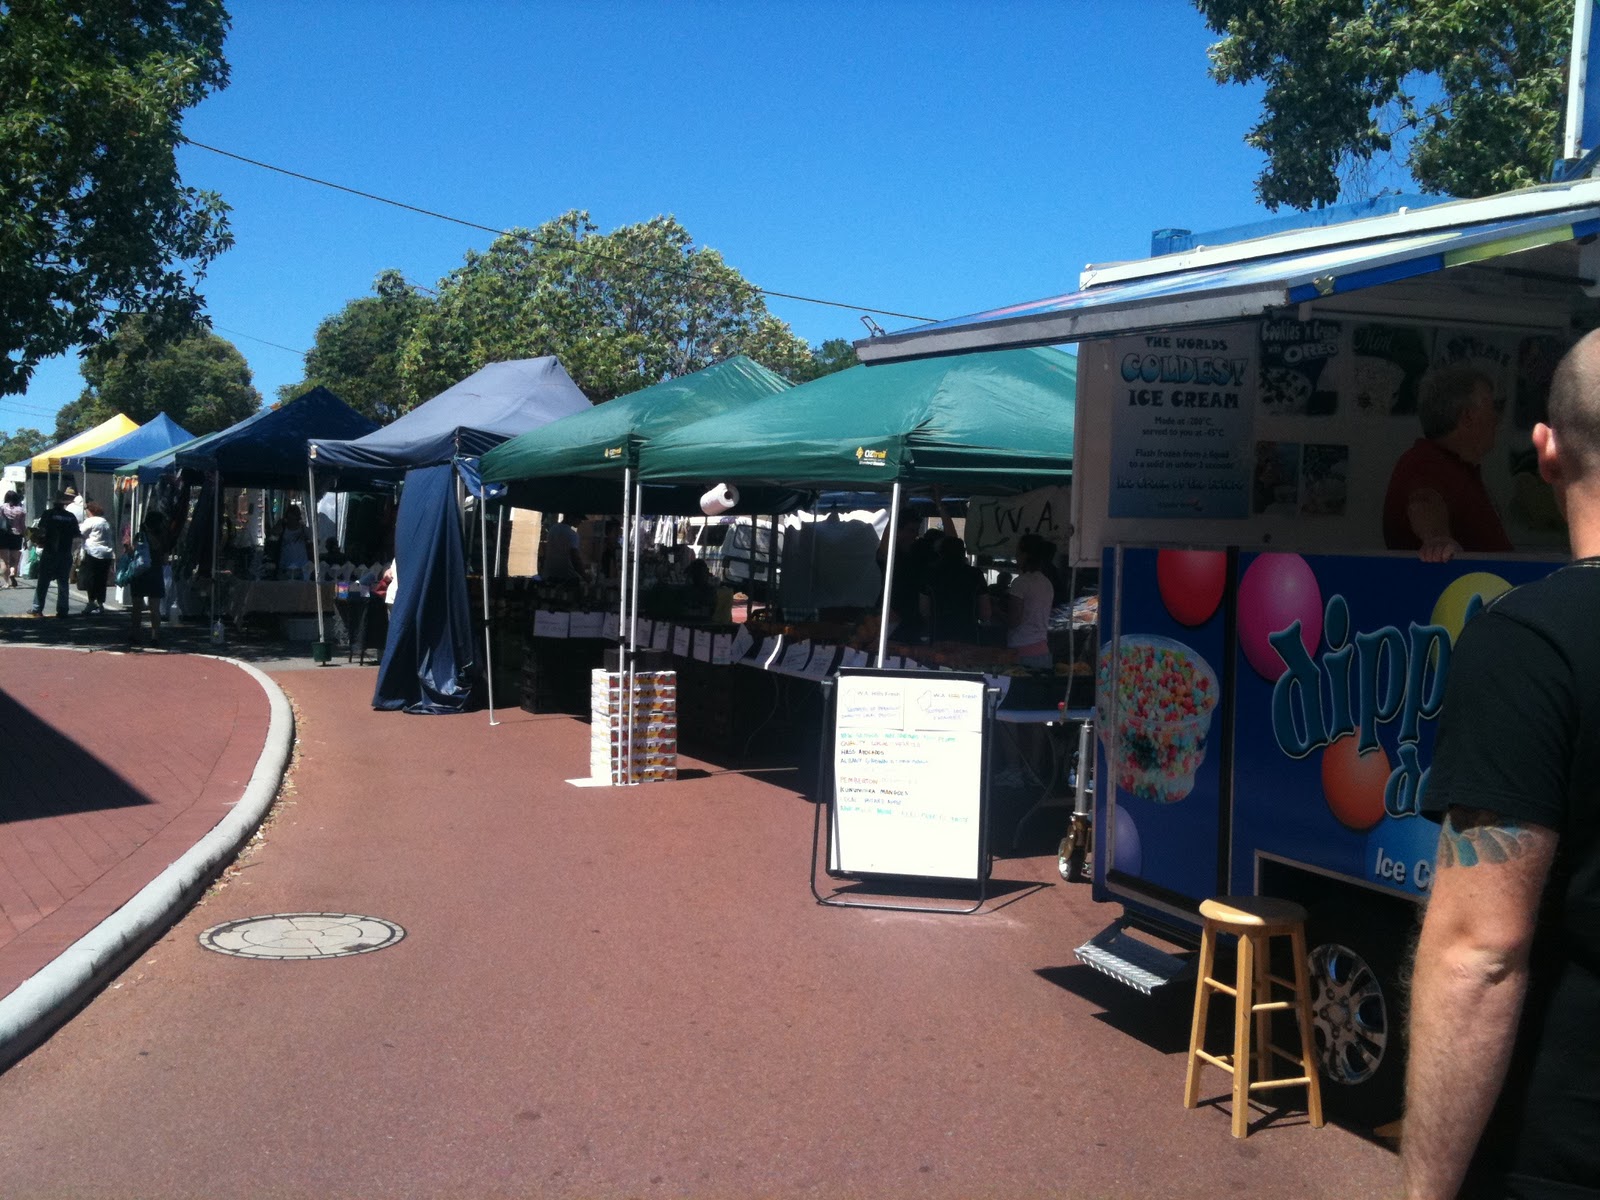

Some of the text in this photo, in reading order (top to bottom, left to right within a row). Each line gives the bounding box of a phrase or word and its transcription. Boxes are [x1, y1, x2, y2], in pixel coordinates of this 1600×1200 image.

[1145, 336, 1228, 351] THE WORLDS
[1283, 343, 1338, 364] OREO
[1120, 352, 1249, 387] COLDEST
[1128, 389, 1239, 409] ICE CREAM
[1154, 416, 1175, 425] Made
[1142, 428, 1167, 436] served
[1179, 430, 1193, 438] you
[1135, 448, 1156, 458] Flash
[1156, 449, 1181, 458] frozen
[1182, 449, 1201, 459] from
[1146, 460, 1164, 469] solid
[1166, 461, 1173, 469] in
[1174, 461, 1197, 469] under
[994, 499, 1059, 534] W.A.
[1374, 846, 1436, 889] Ice C
